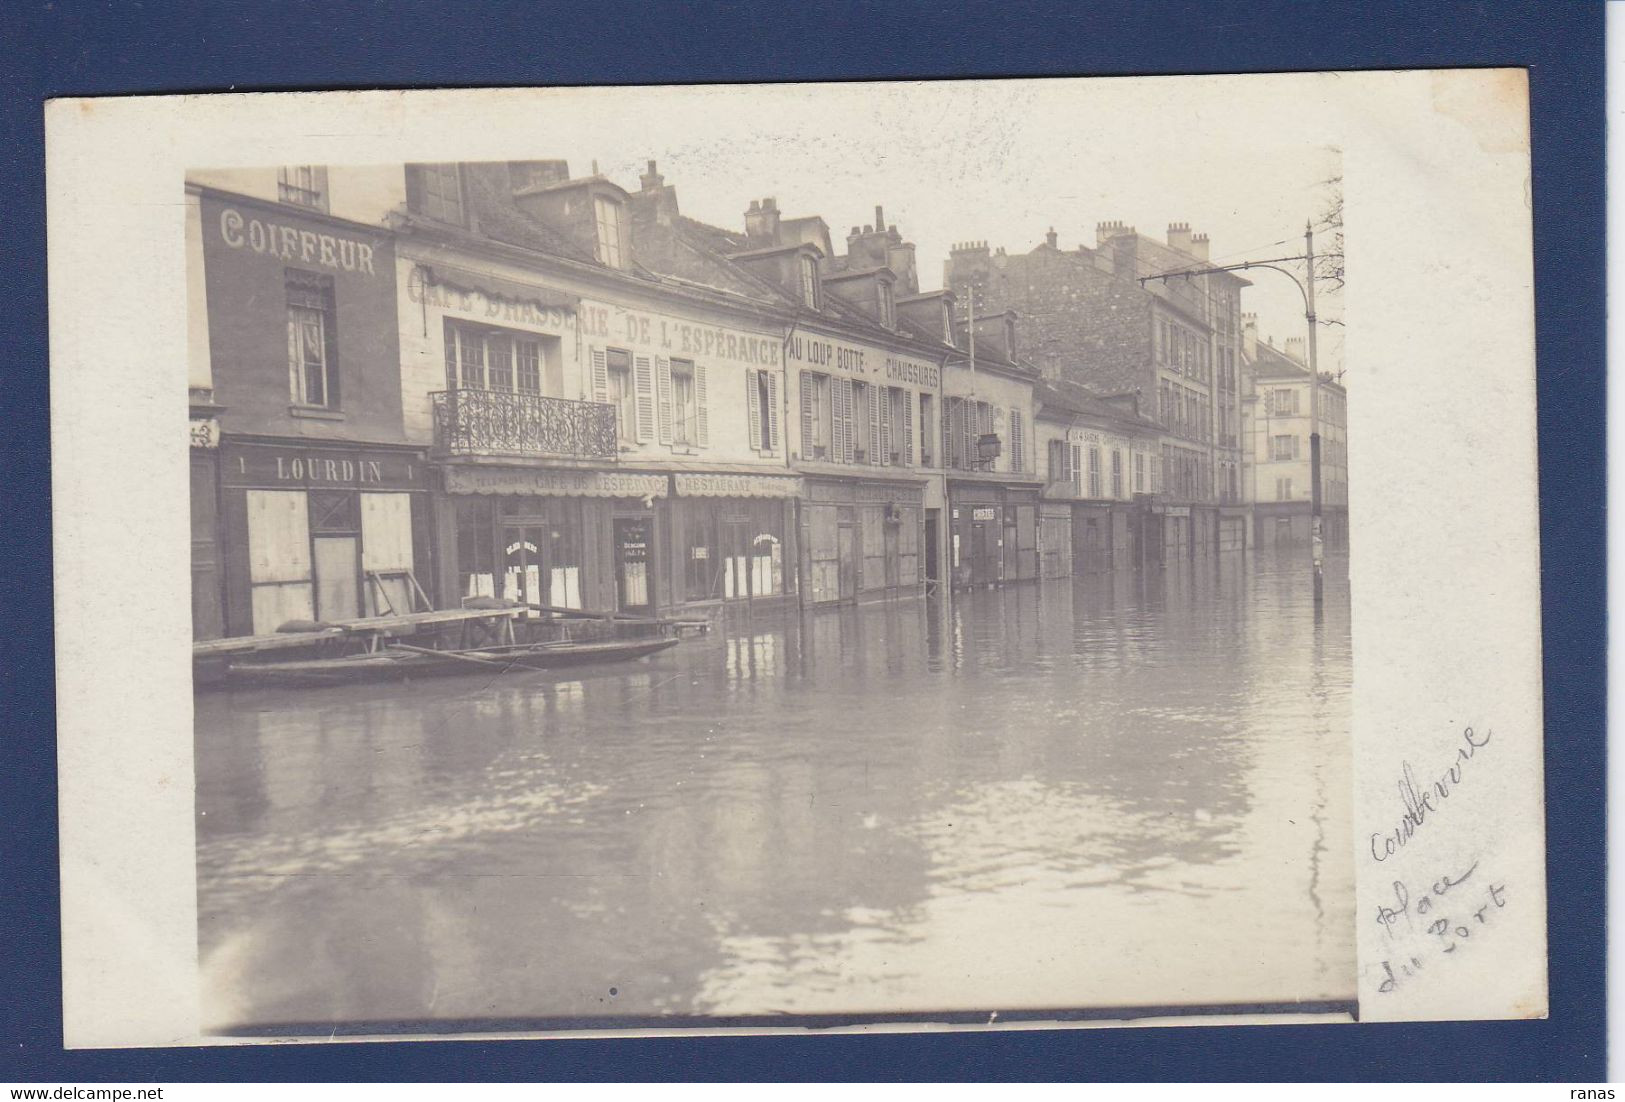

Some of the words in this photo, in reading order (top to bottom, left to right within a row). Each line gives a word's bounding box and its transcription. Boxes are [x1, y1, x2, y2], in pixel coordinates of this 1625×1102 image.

[220, 208, 376, 276] COIFFEUR
[625, 313, 651, 344] DE
[661, 319, 779, 367] L'ESPÉRANCE
[788, 336, 803, 361] AU
[807, 339, 833, 367] LOUP
[886, 358, 938, 389] CHAUSSURES
[276, 457, 382, 482] LOURDIN
[1378, 956, 1423, 993] du
[1427, 883, 1506, 953] Port
